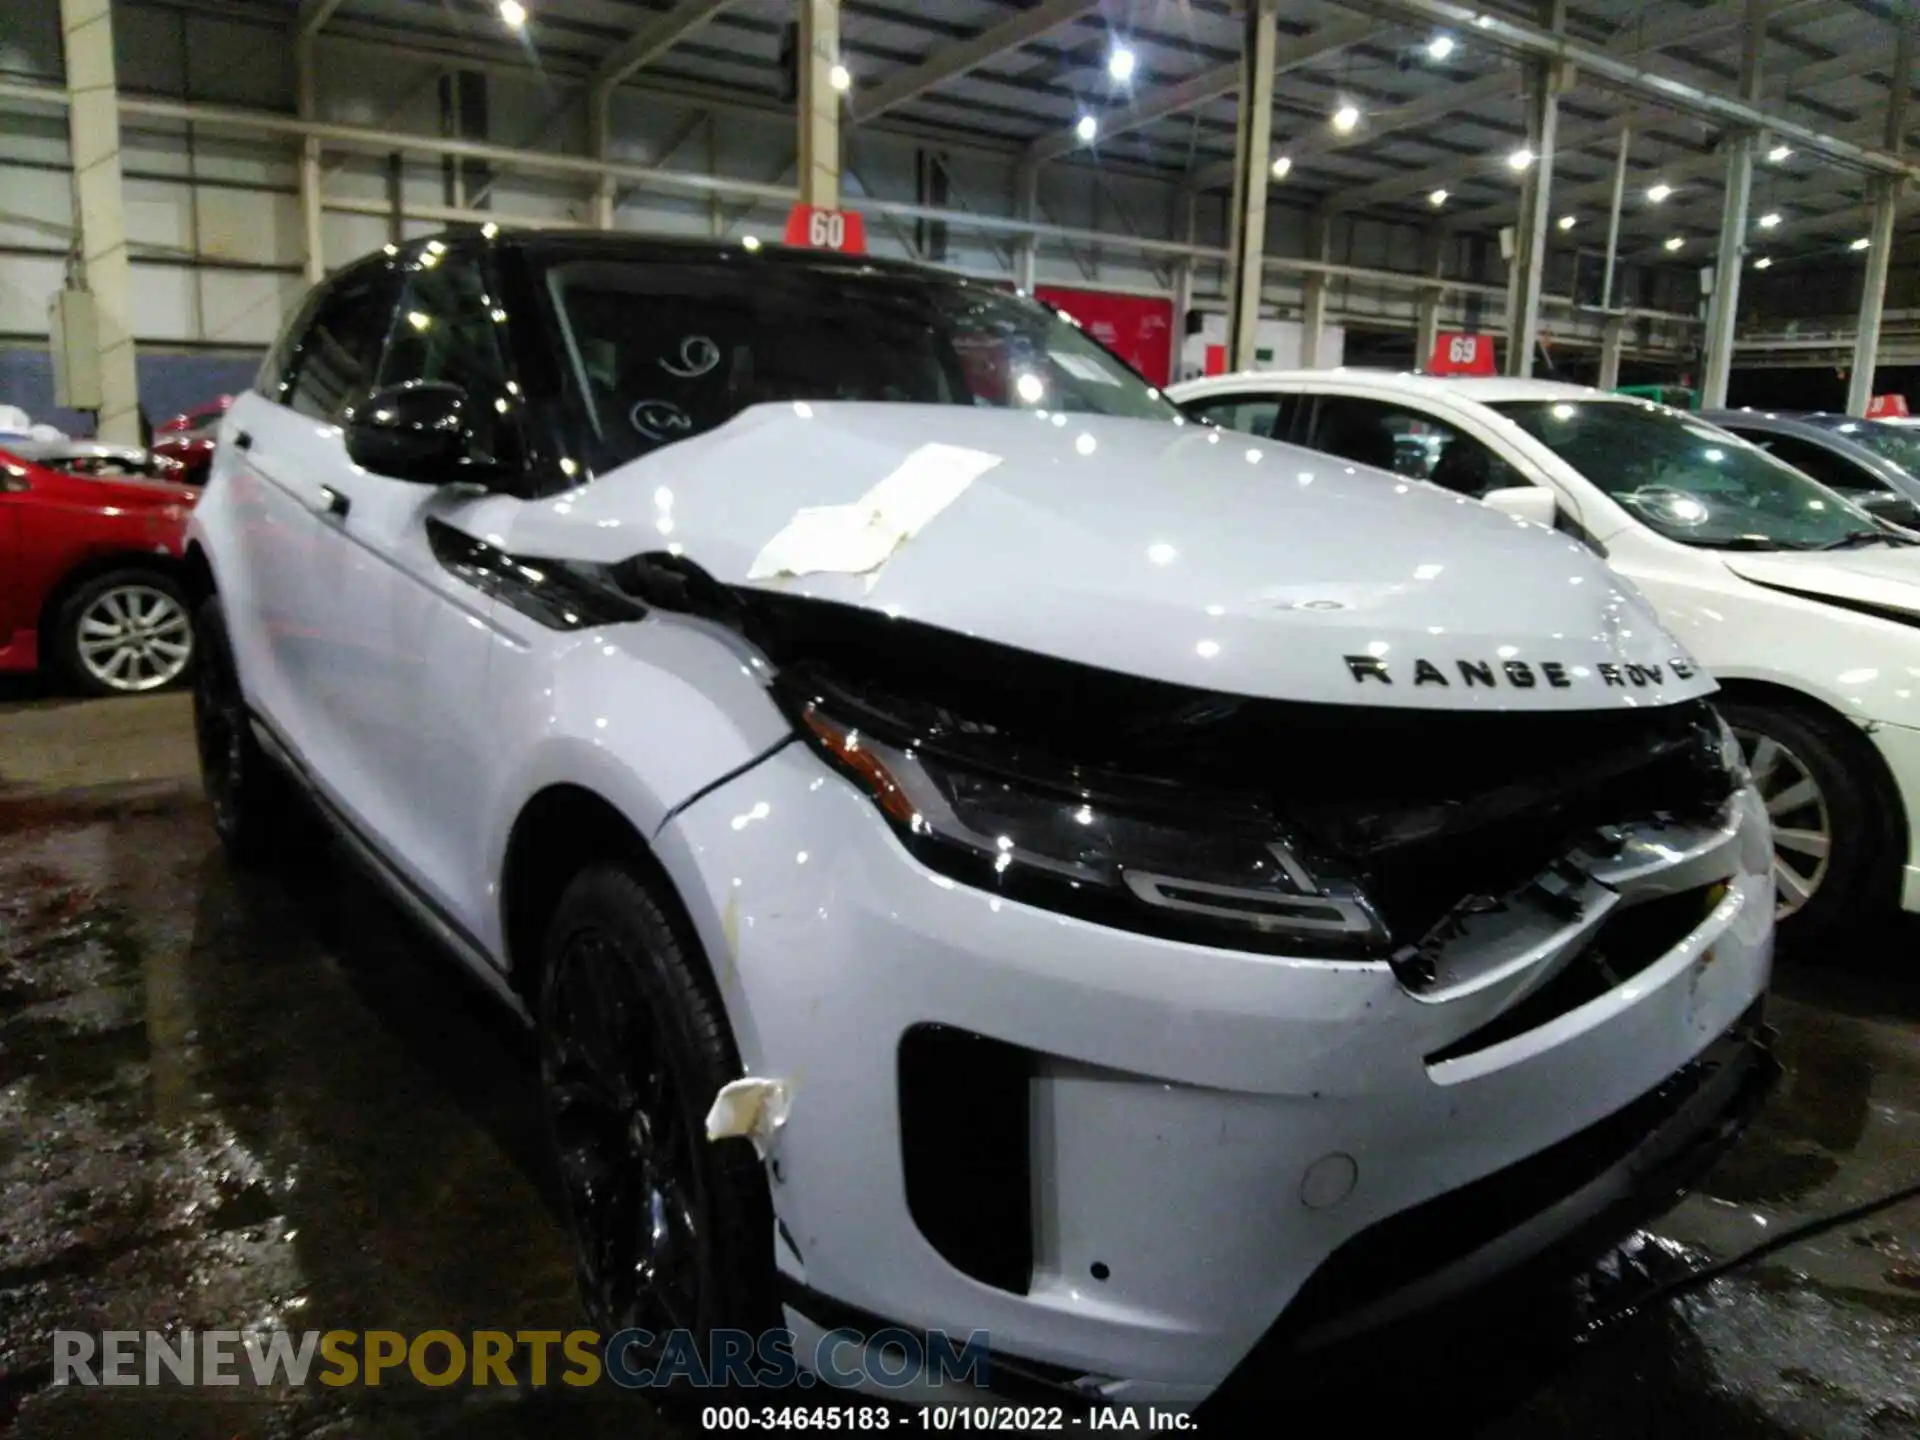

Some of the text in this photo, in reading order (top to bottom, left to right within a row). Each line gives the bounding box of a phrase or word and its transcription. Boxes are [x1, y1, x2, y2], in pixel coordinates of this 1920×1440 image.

[810, 210, 845, 250] 60
[1449, 335, 1477, 364] 69
[1343, 654, 1698, 688] RANGE ROVE
